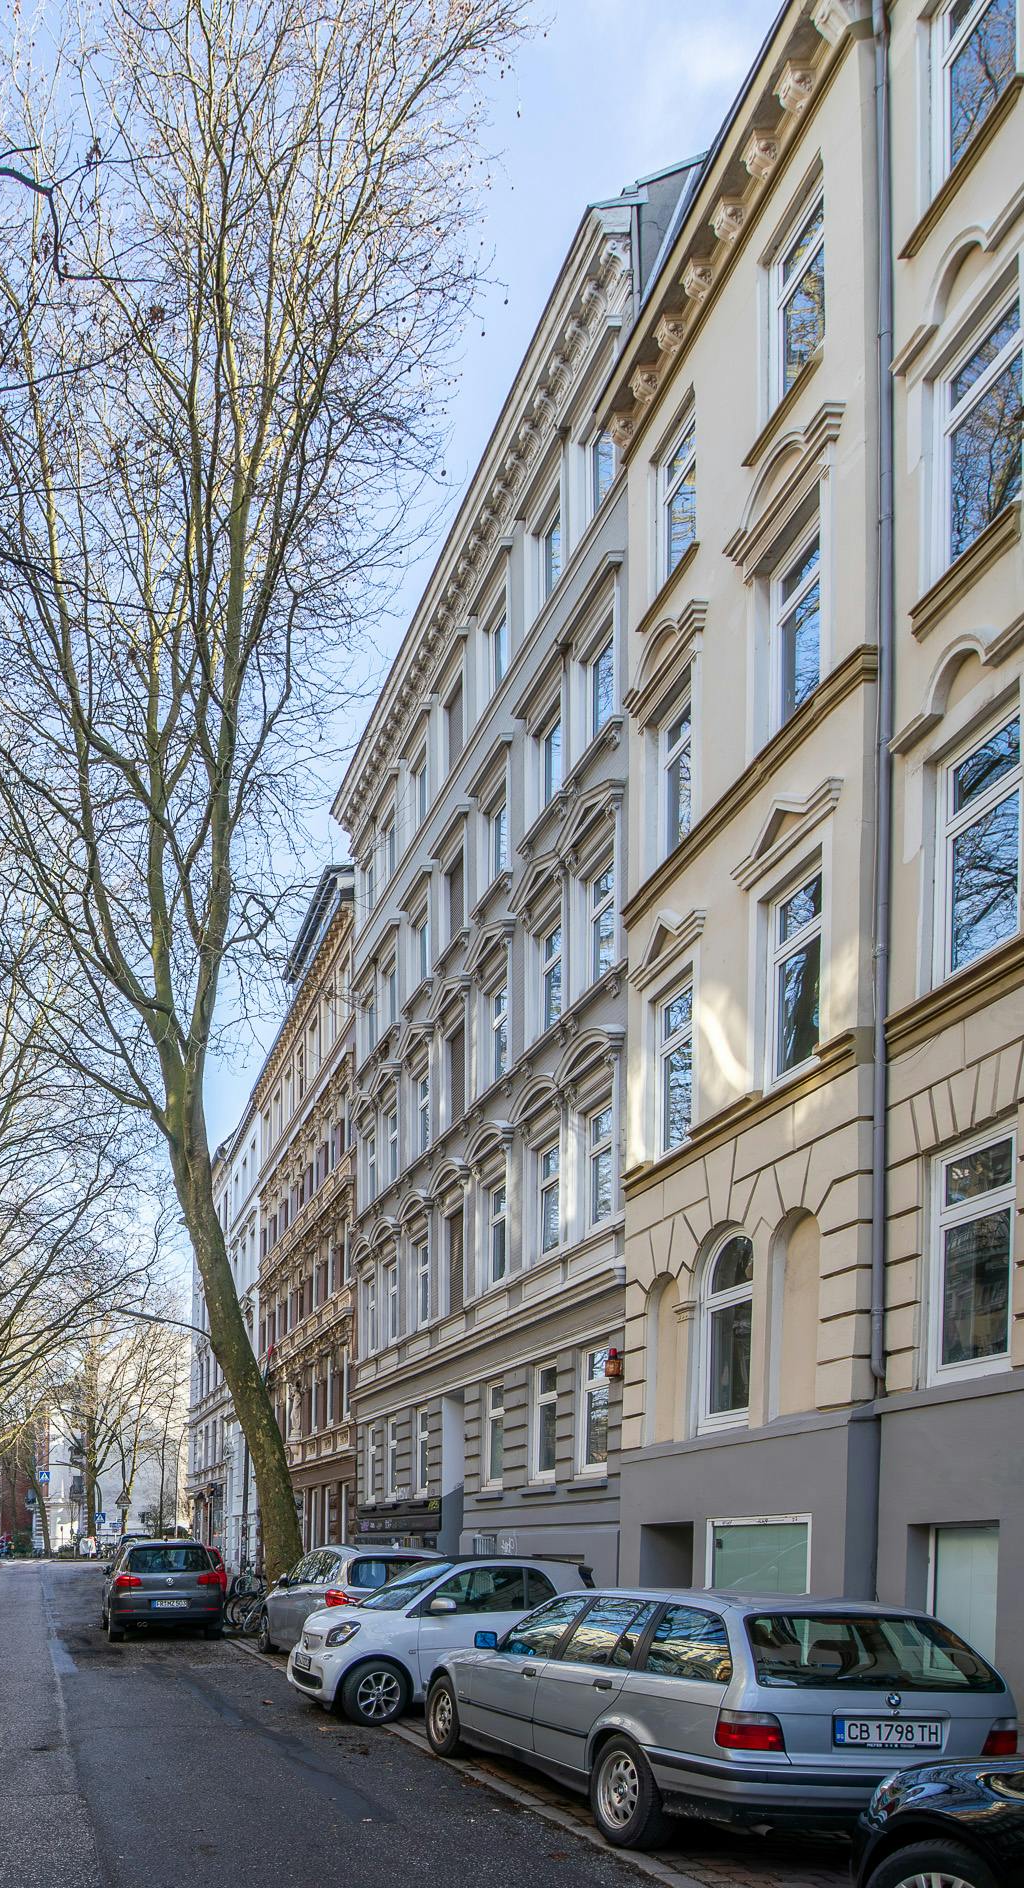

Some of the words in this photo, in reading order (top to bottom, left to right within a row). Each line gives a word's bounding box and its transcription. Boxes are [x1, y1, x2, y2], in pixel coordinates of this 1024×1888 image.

[847, 1723, 871, 1741] CB
[875, 1723, 915, 1742] 1798
[917, 1724, 939, 1743] TH
